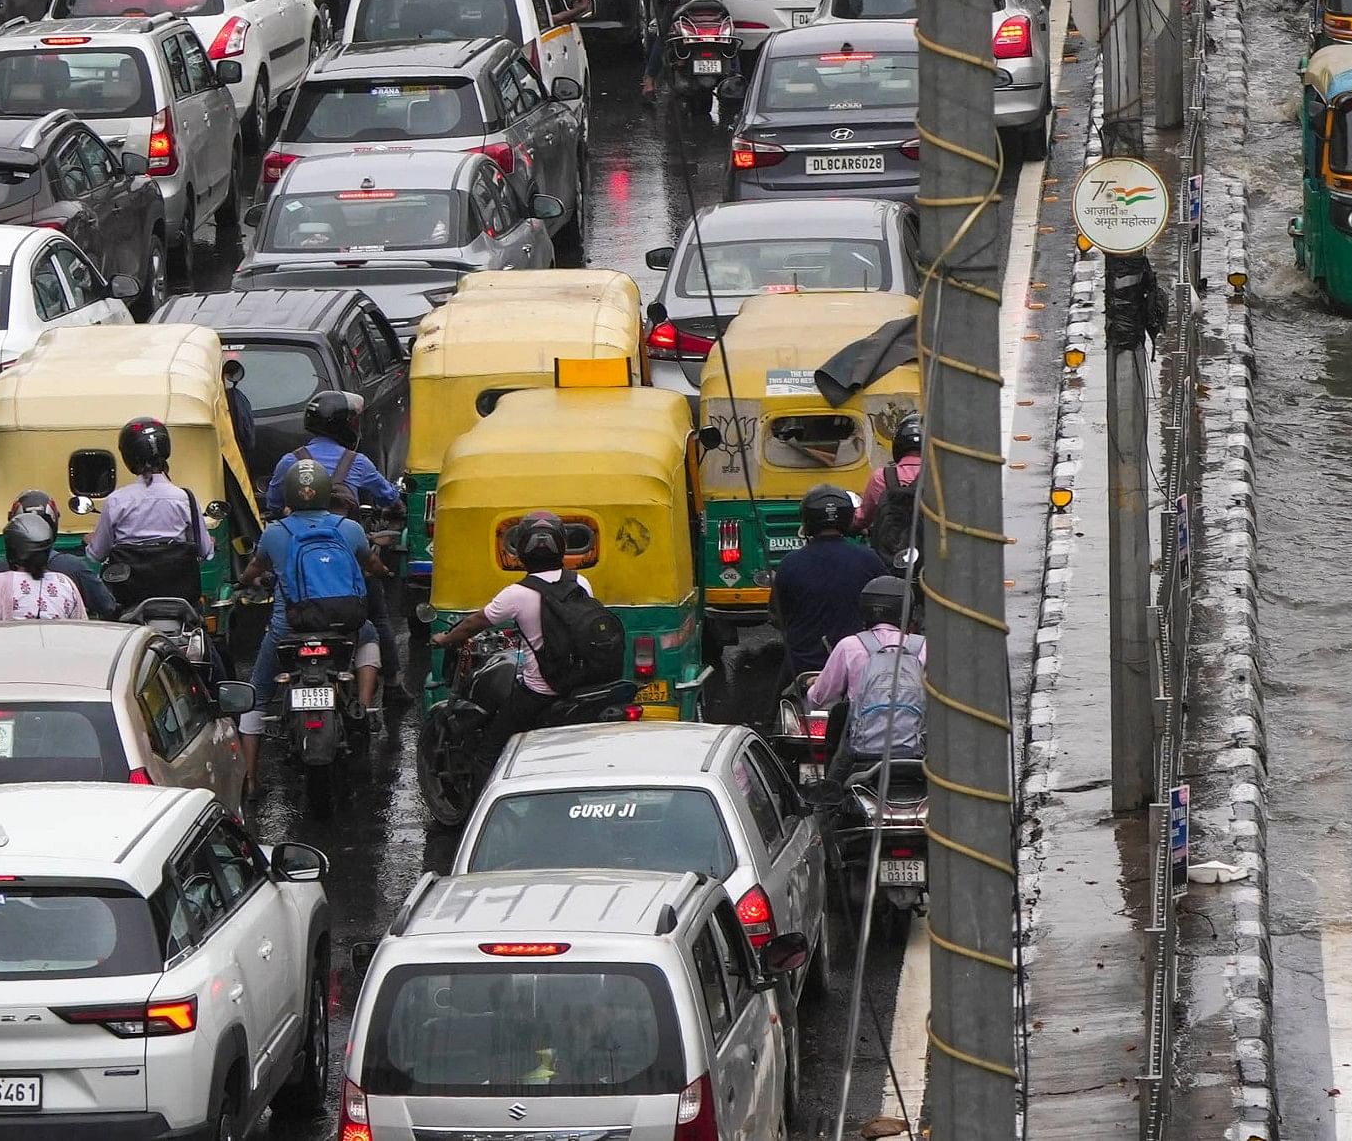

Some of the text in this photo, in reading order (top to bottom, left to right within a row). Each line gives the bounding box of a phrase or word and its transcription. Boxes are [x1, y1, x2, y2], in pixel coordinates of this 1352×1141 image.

[812, 155, 883, 173] DL8CAR6028
[1084, 204, 1119, 218] आज़ादी
[1094, 214, 1158, 230] अमृत महोत्सव
[769, 539, 807, 548] BUNTY
[723, 572, 738, 580] CNG
[301, 698, 329, 707] F1216
[569, 803, 637, 819] GURU JI
[887, 861, 919, 871] DL14S
